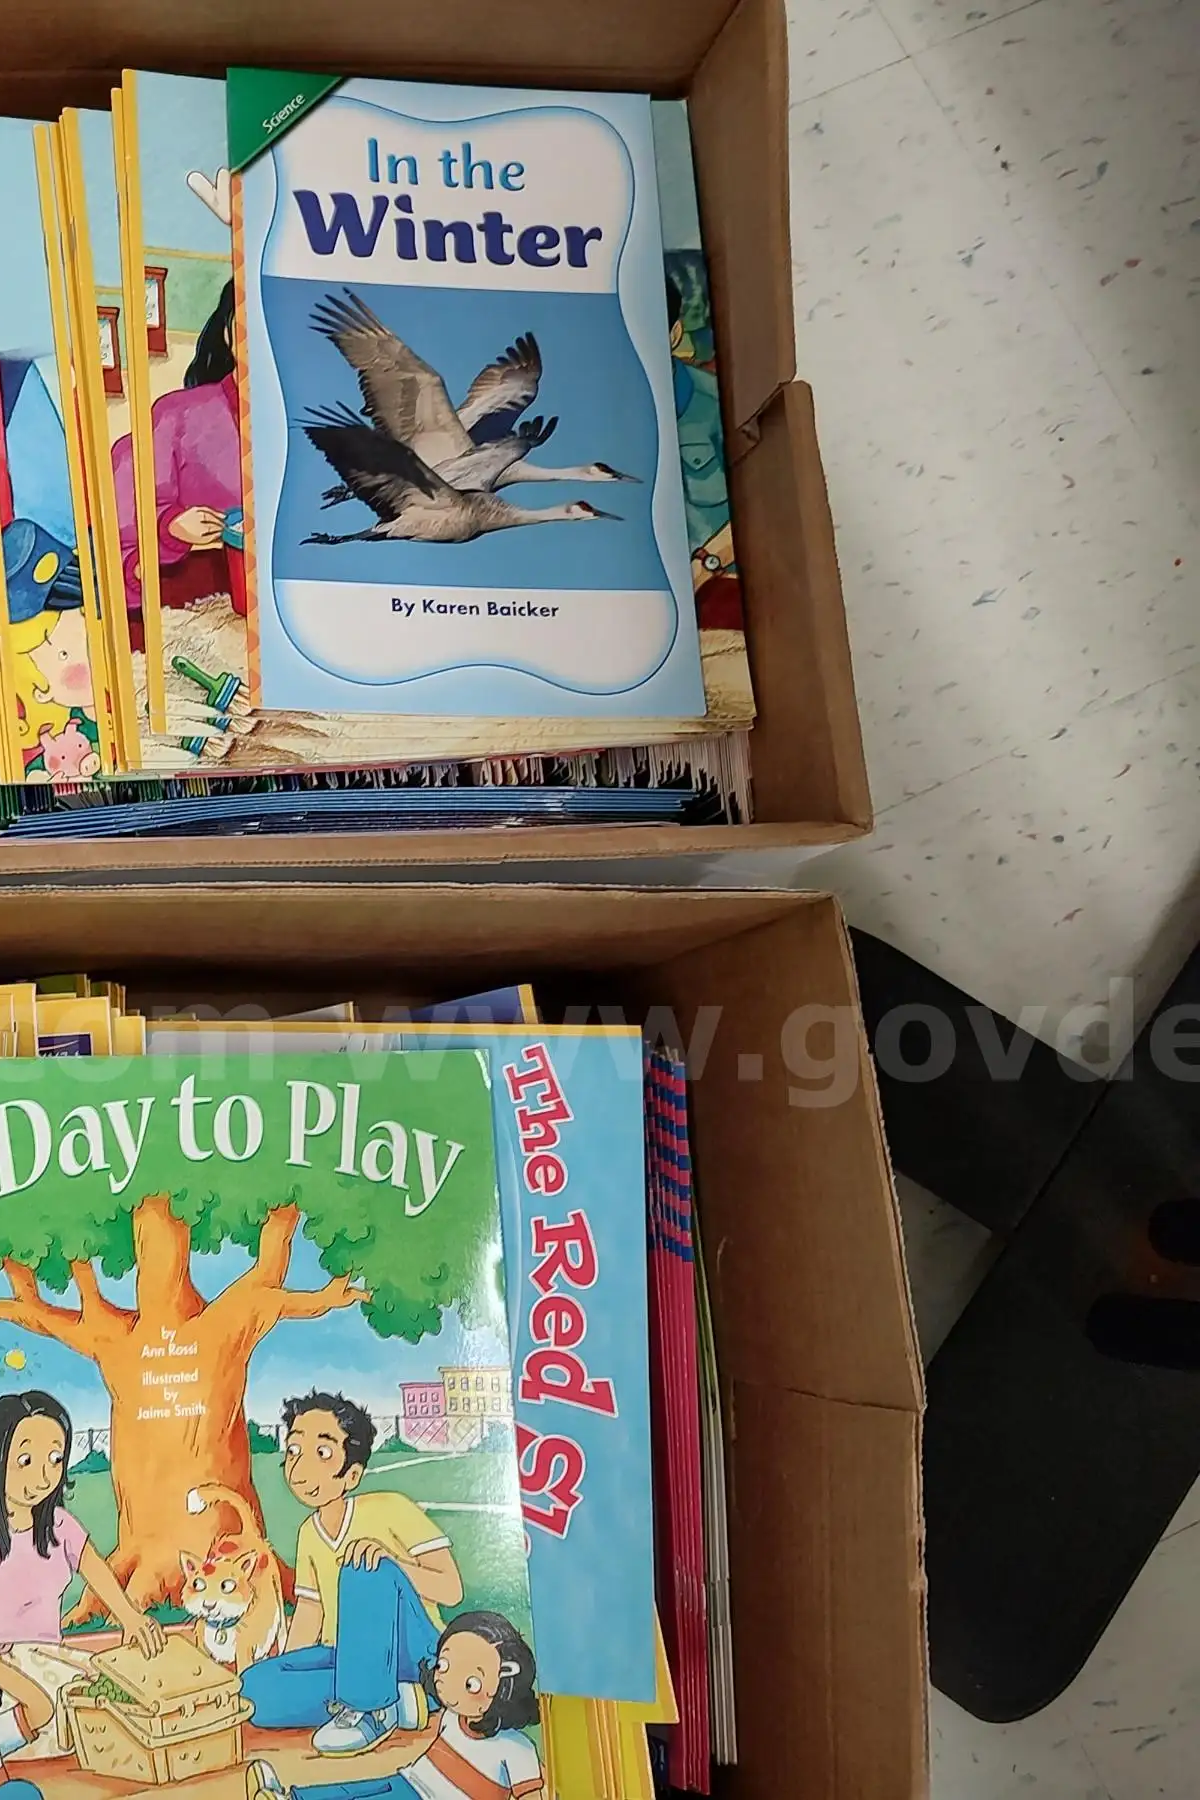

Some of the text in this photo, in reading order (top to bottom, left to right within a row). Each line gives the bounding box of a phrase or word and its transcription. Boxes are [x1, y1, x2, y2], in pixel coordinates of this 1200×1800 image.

[262, 93, 305, 134] Science
[368, 137, 526, 191] In the
[292, 189, 602, 268] Winter
[391, 598, 559, 618] By Karen Baicker
[503, 1043, 574, 1196] The
[170, 1074, 264, 1162] to
[284, 1079, 466, 1218] Play
[518, 1209, 619, 1418] Red
[141, 1341, 198, 1358] Ann Rossi
[161, 1325, 176, 1344] by
[142, 1368, 199, 1386] illustrated
[136, 1400, 206, 1420] Jaime Smith
[163, 1386, 178, 1404] by
